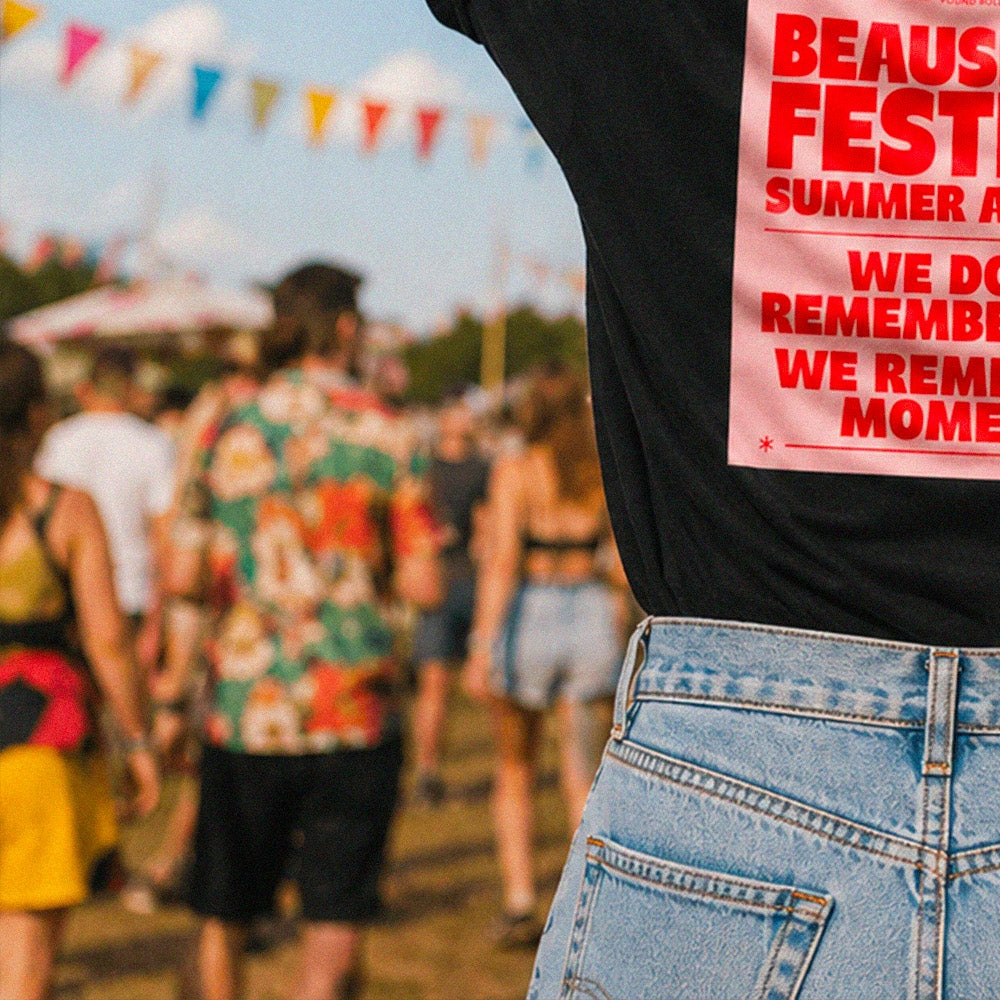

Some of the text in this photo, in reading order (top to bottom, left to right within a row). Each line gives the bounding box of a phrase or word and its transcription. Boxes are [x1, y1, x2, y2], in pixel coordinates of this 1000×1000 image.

[765, 176, 967, 223] SUMMER
[847, 250, 932, 295] WE
[774, 348, 858, 392] WE
